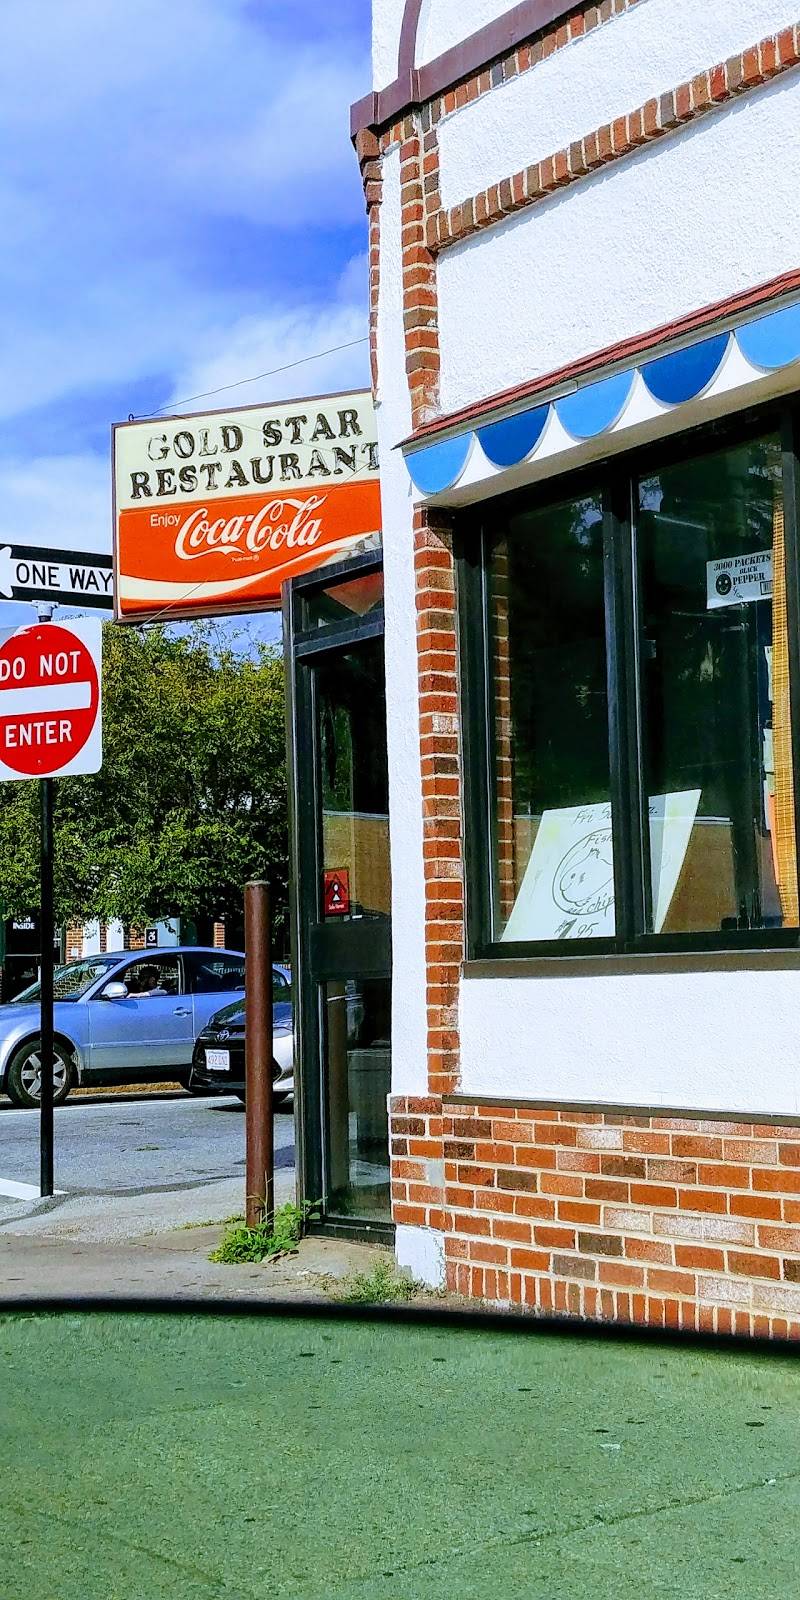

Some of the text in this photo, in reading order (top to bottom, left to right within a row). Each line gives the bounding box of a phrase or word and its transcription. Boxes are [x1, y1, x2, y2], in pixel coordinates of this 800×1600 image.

[147, 408, 363, 462] GOLD STAR
[129, 441, 379, 499] RESTAURANT
[150, 494, 327, 560] Enjoy Coca-Cola
[713, 554, 771, 571] 3000 PACKETS
[739, 565, 758, 574] BLACK
[16, 563, 113, 592] ONE WAY
[732, 572, 765, 585] PEPPER
[0, 651, 81, 681] DO NOT
[5, 719, 72, 748] ENTER
[13, 922, 35, 930] INSIDE
